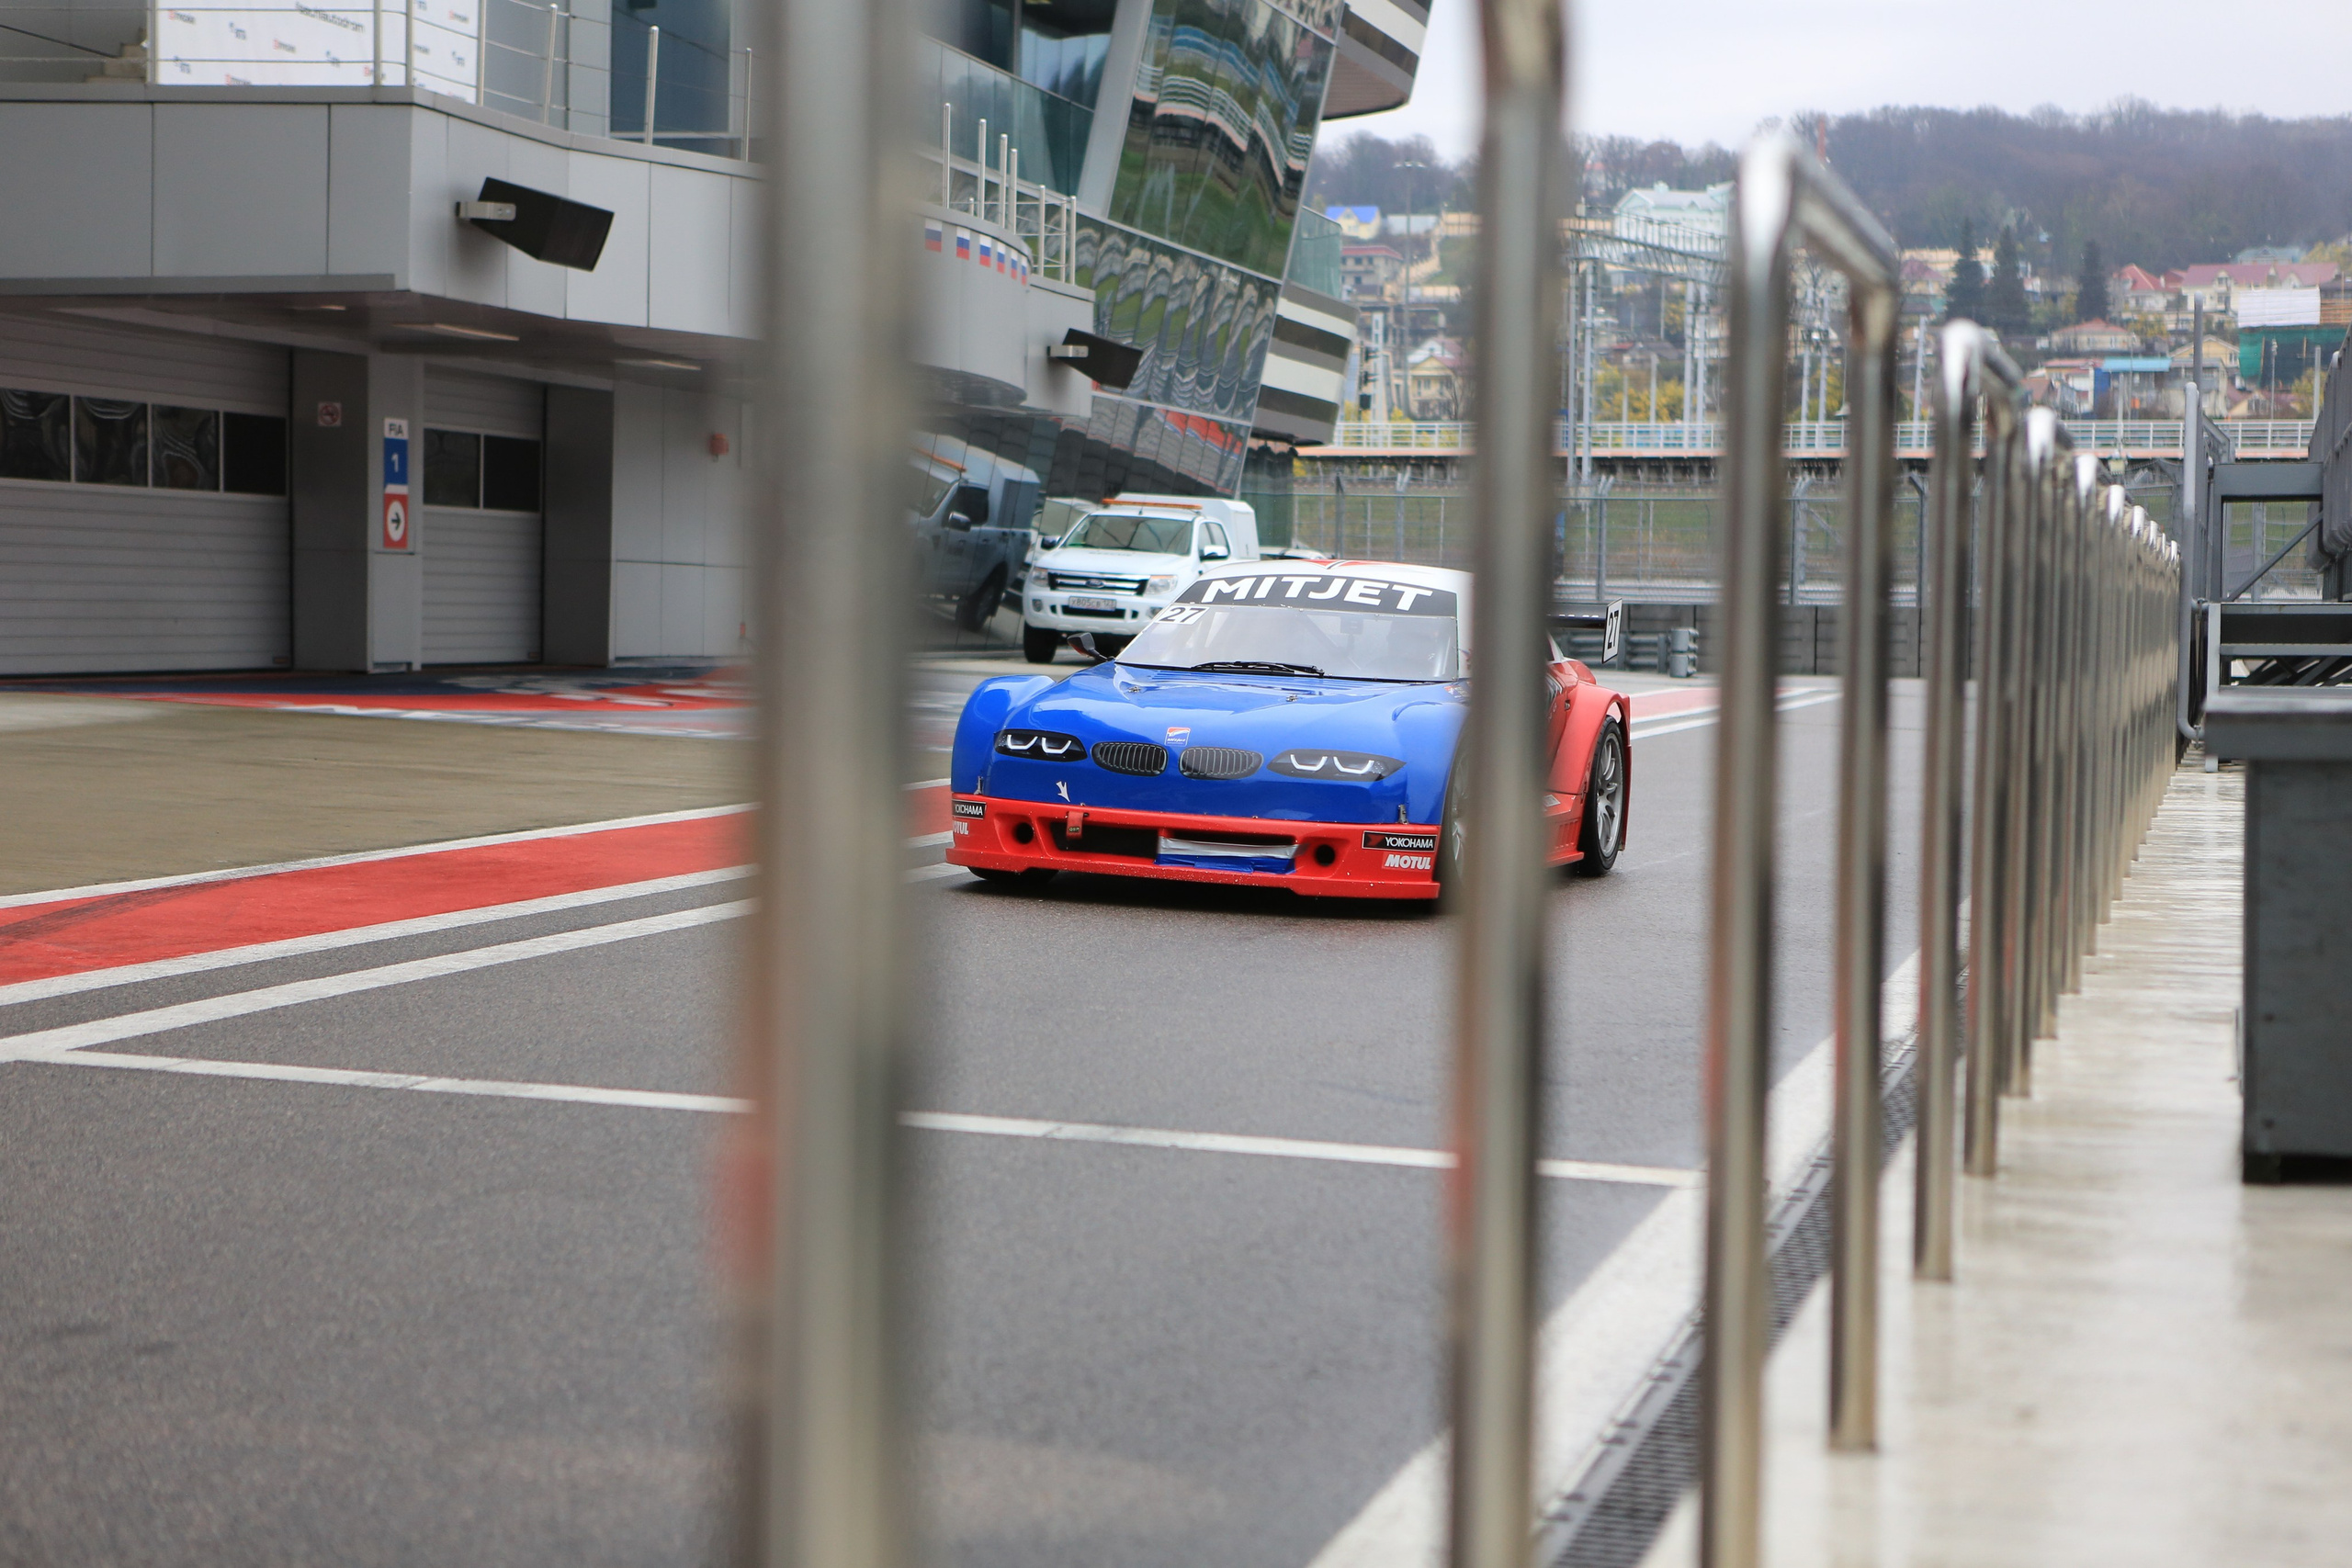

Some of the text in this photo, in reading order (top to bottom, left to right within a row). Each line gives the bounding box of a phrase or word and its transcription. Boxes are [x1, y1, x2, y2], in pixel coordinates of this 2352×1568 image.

[389, 423, 403, 435] FIA
[391, 453, 399, 472] 1
[1201, 577, 1433, 611] MITJET
[1159, 607, 1205, 623] 27
[1608, 610, 1620, 649] 27
[955, 804, 983, 816] OKOHAMA
[1385, 837, 1433, 848] YOKOHAMA
[1385, 854, 1430, 870] MOTUL
